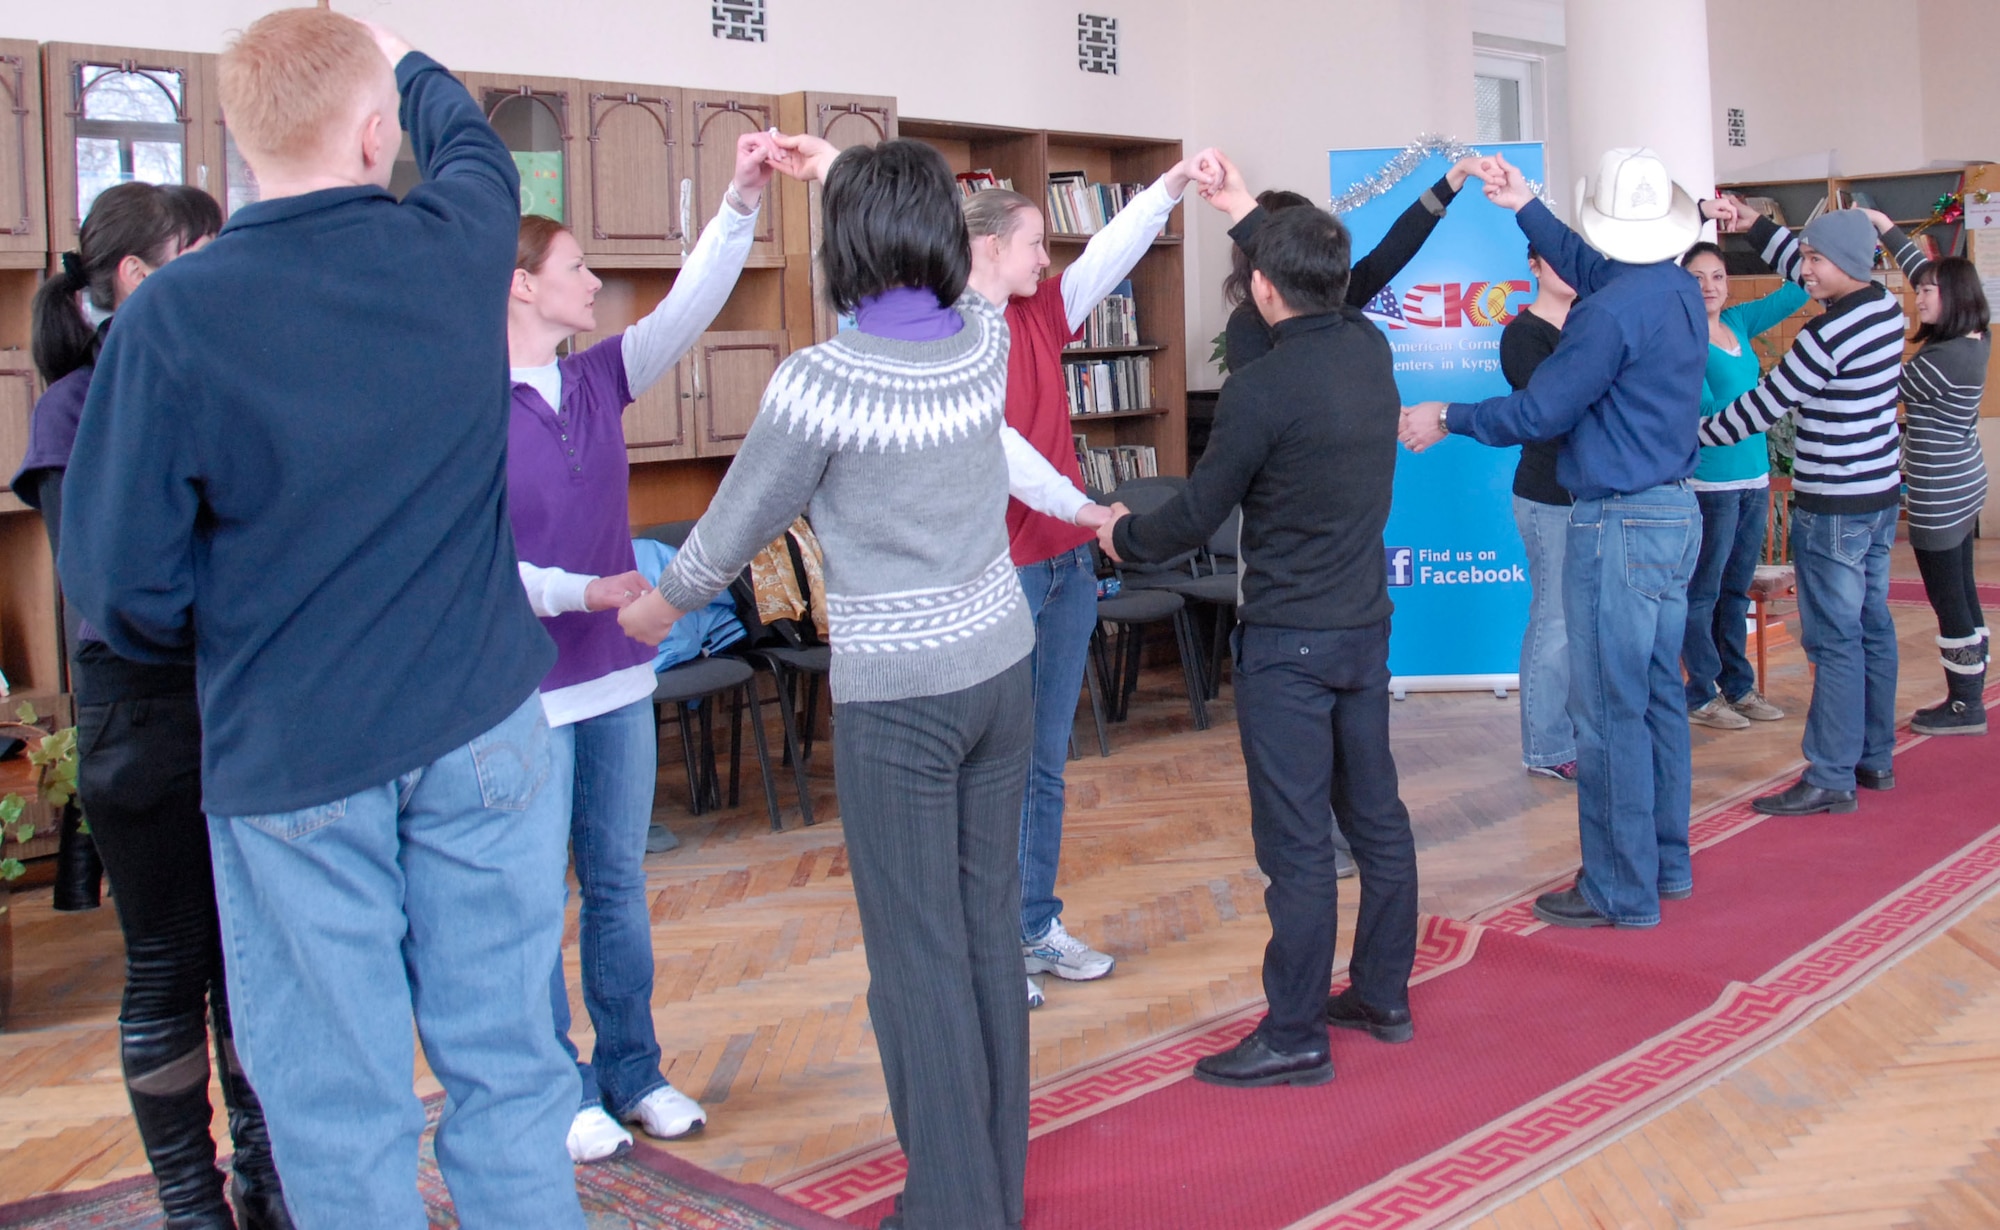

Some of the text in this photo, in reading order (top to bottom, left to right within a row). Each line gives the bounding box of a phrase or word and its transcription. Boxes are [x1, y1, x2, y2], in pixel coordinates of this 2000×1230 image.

[1389, 338, 1500, 353] American Corne
[1393, 357, 1501, 372] enters in Kyrgy
[1419, 549, 1496, 562] Find us on
[1420, 564, 1526, 585] Facebook
